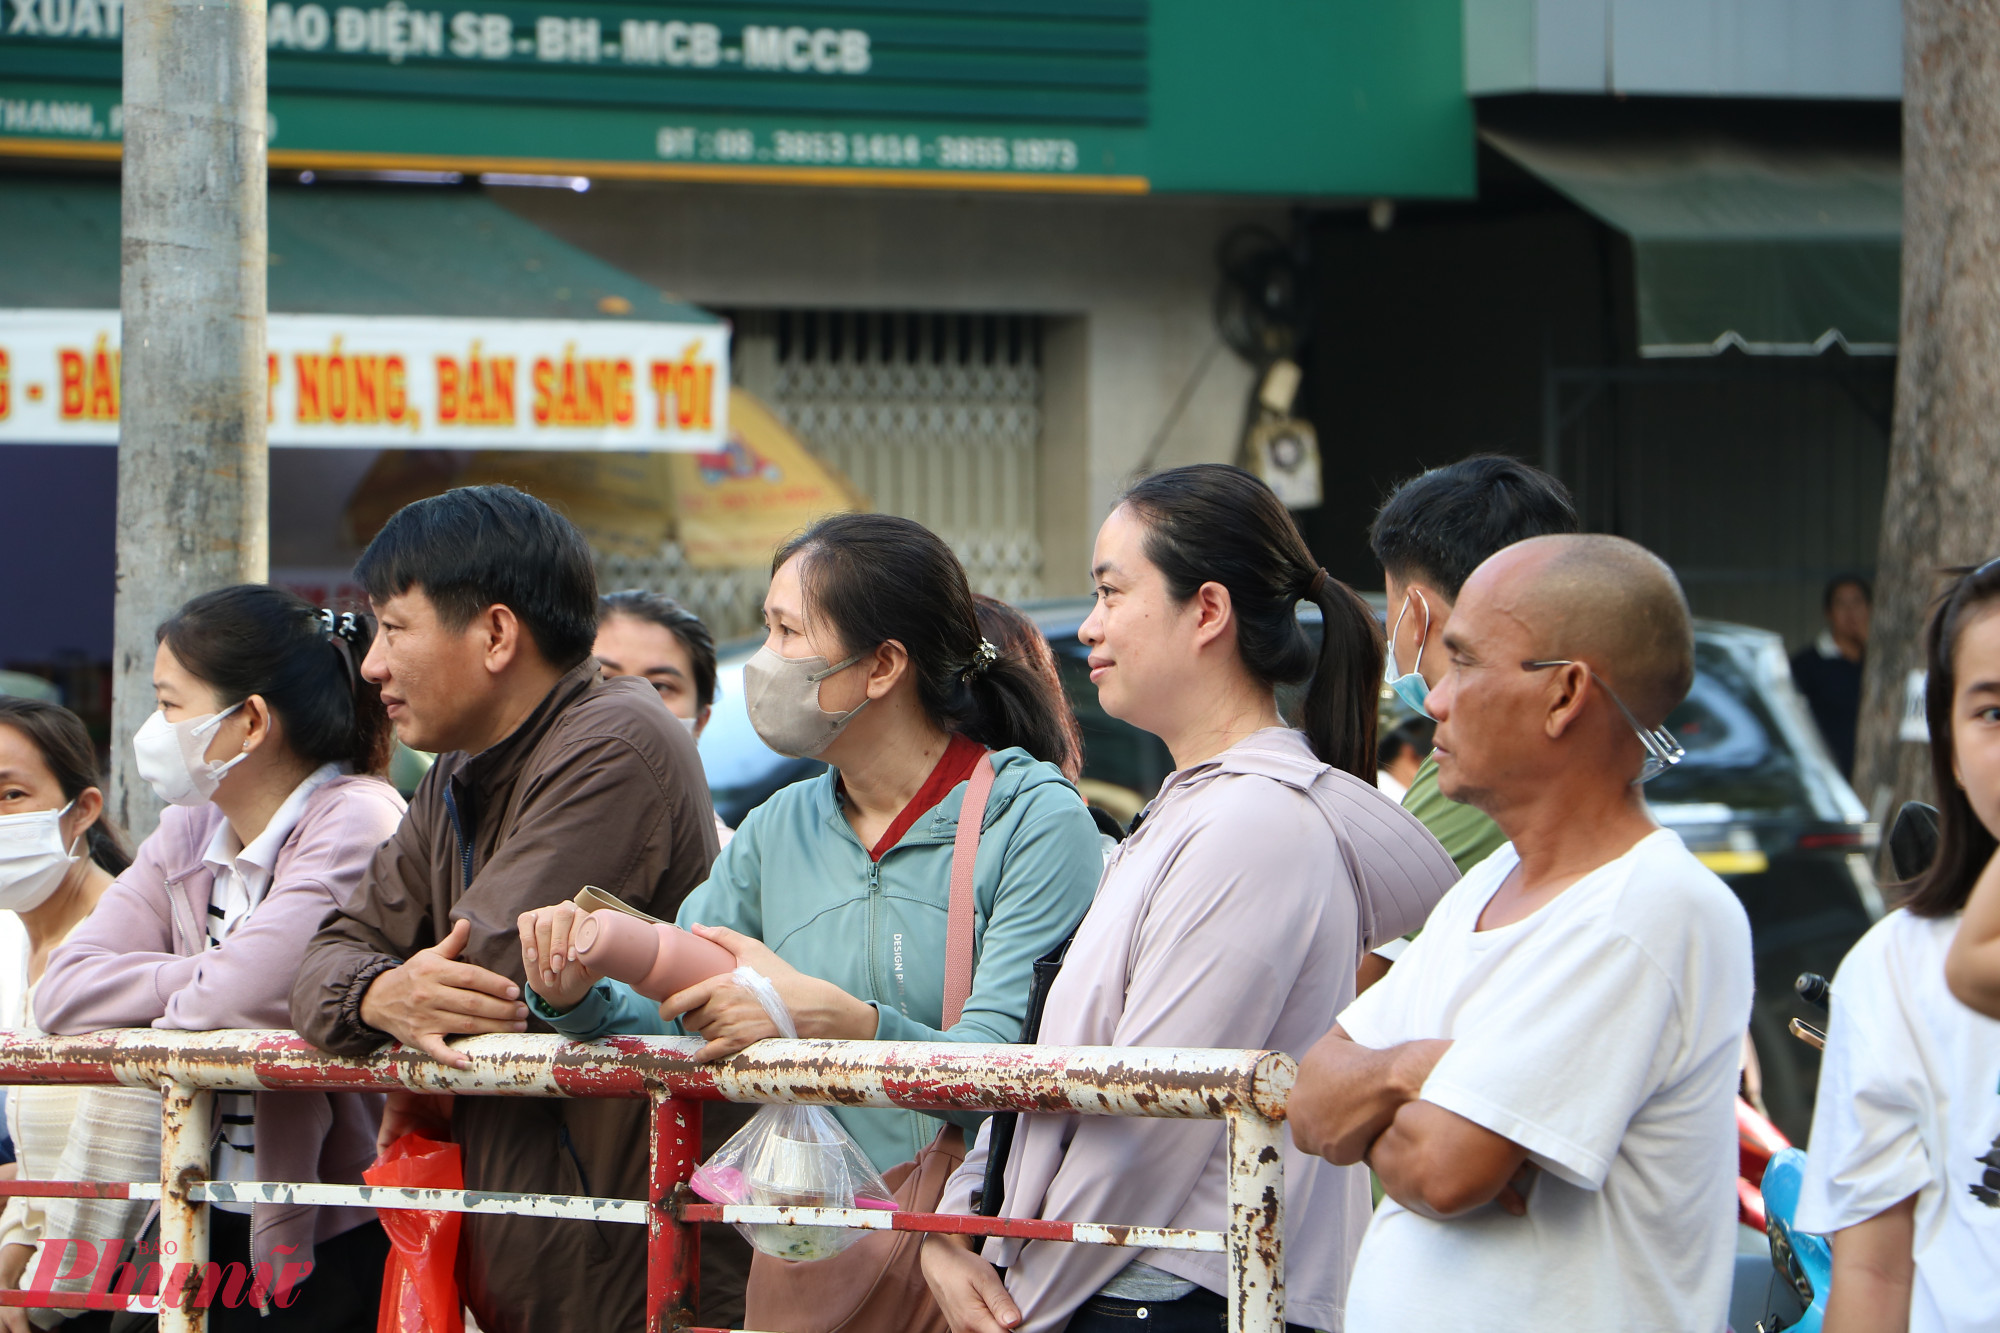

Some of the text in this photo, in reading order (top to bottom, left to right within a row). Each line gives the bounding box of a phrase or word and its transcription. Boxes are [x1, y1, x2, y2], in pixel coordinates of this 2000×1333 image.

[436, 339, 516, 424] BÁN
[532, 340, 635, 427] SÁNG
[650, 338, 714, 429] TỐI
[893, 933, 903, 971] DESIGN
